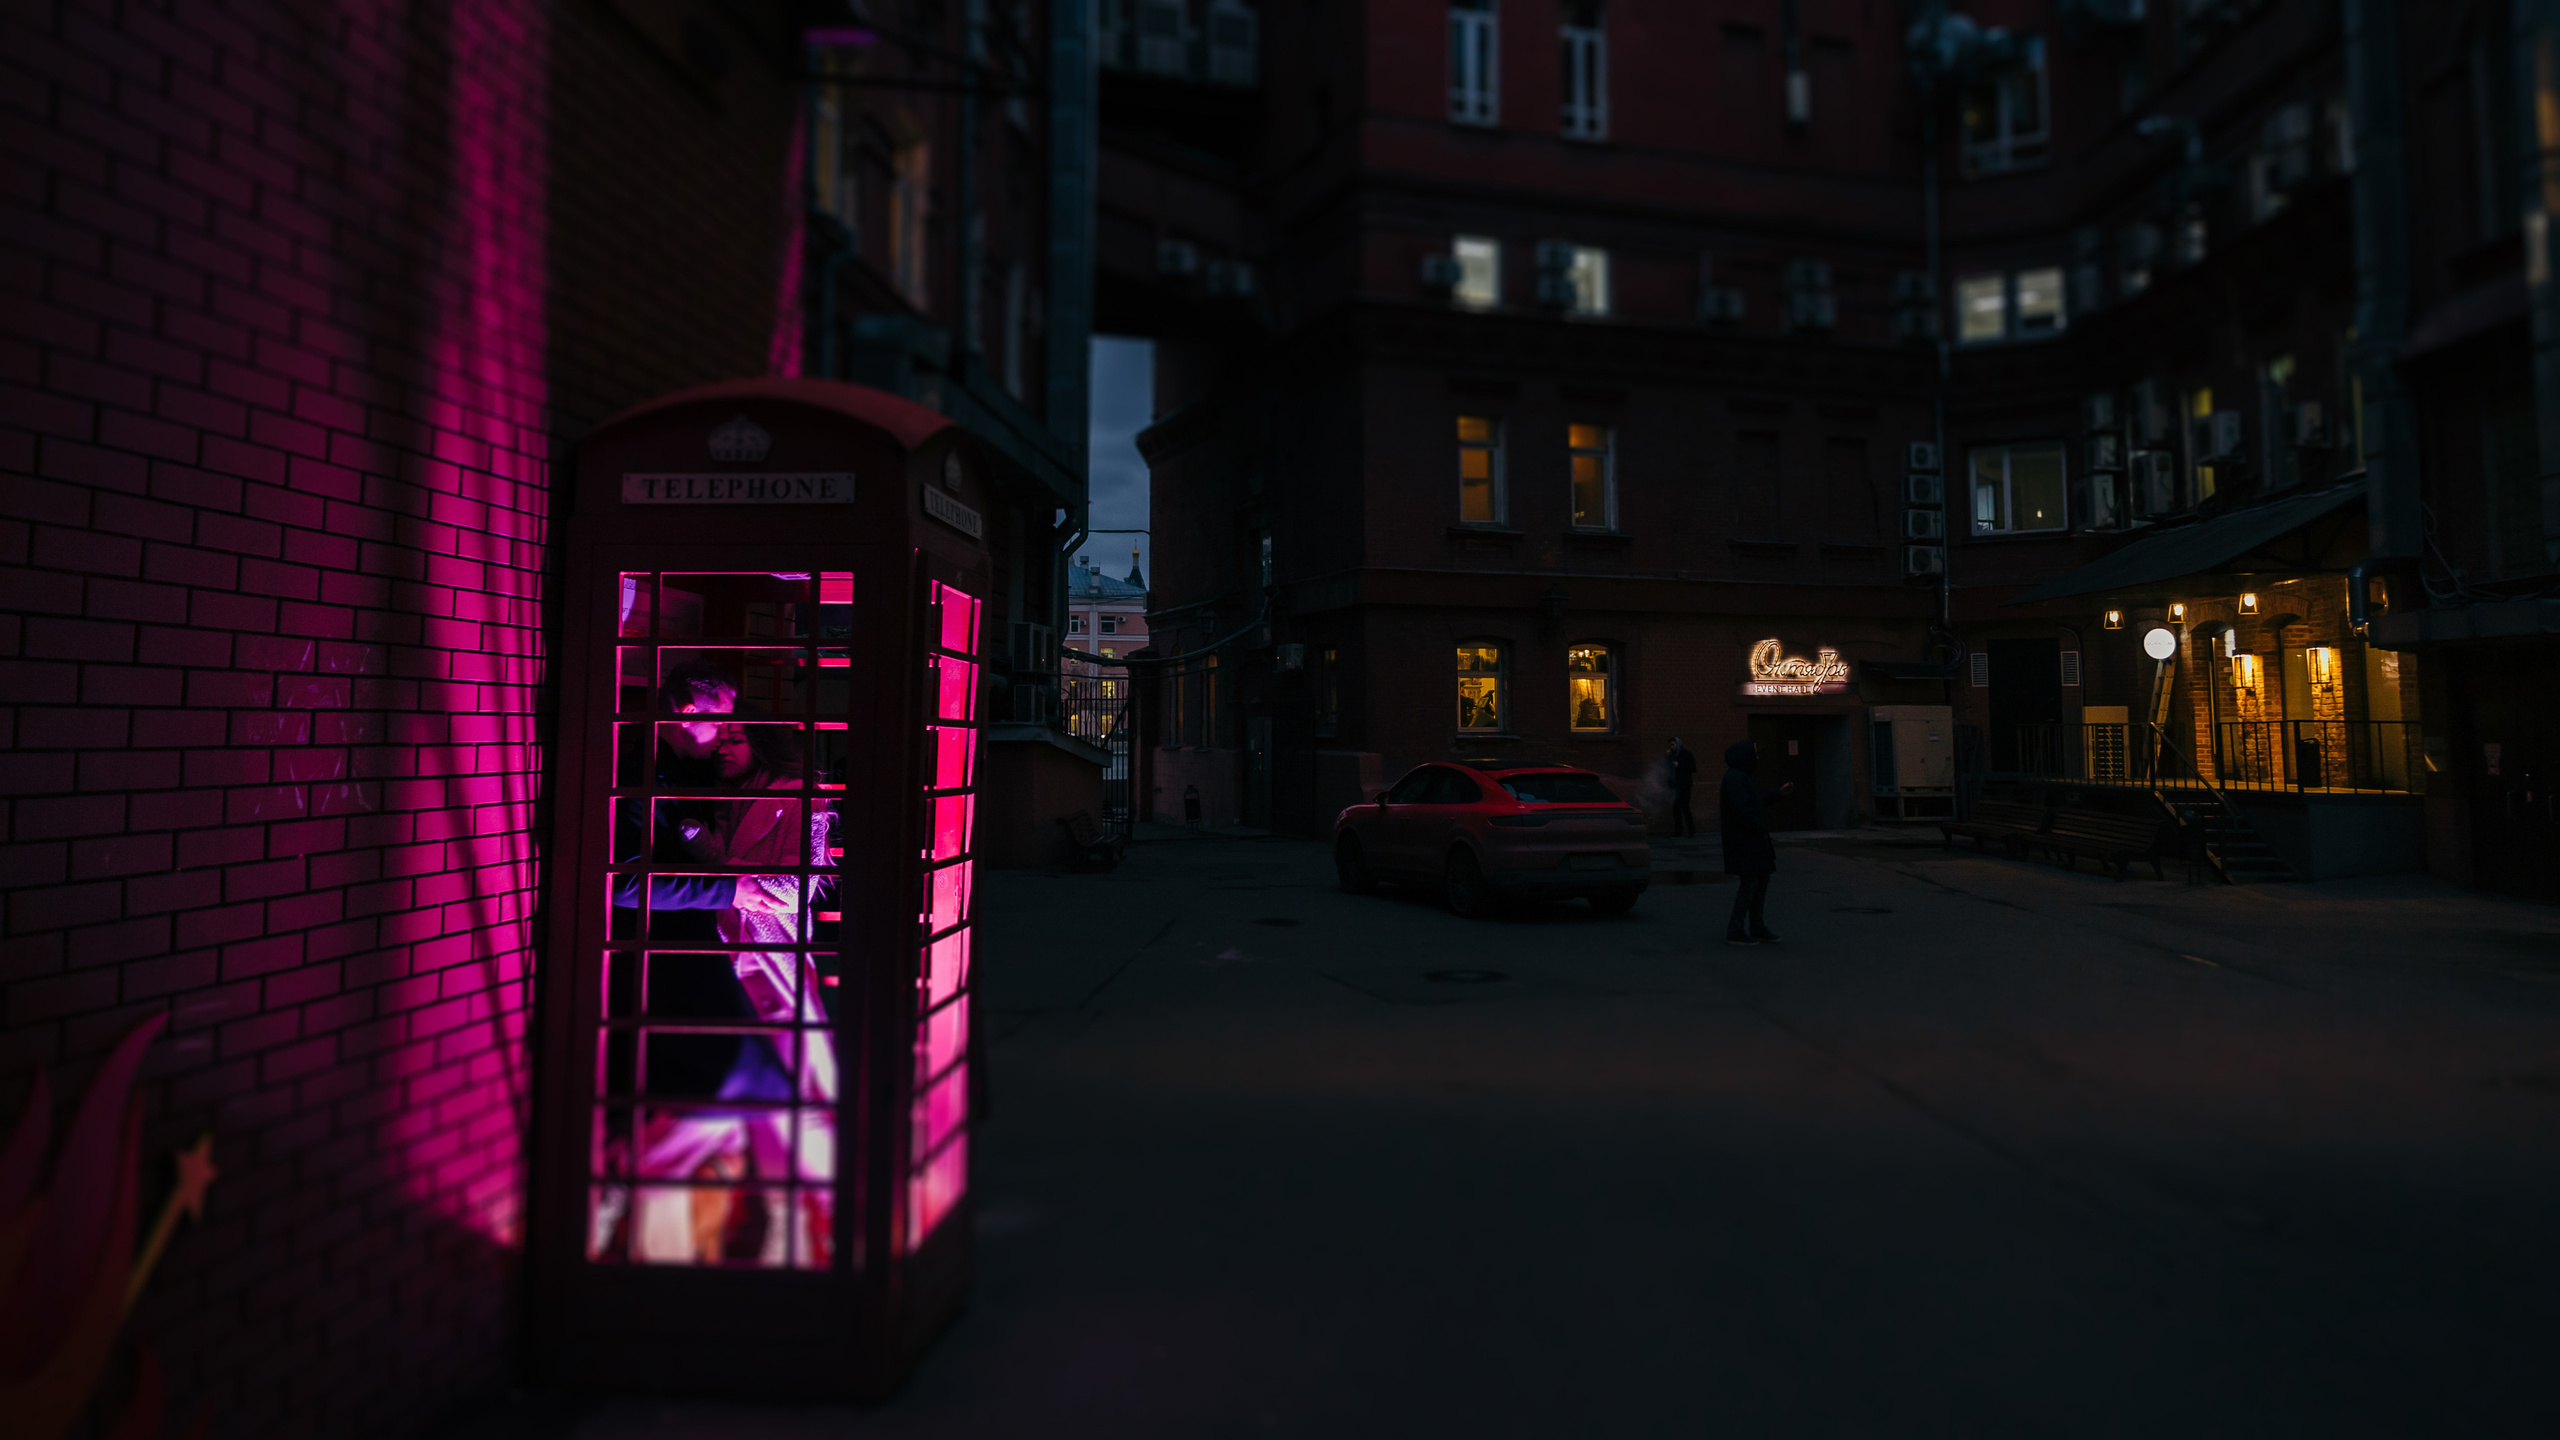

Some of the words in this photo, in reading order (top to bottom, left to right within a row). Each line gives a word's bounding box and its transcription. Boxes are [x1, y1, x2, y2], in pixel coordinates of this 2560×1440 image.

[642, 478, 837, 499] TELEPHONE
[929, 490, 978, 534] TELEPHONE
[1752, 639, 1848, 694] Октябрь
[1756, 685, 1786, 693] EVENT
[1788, 685, 1812, 693] HALL
